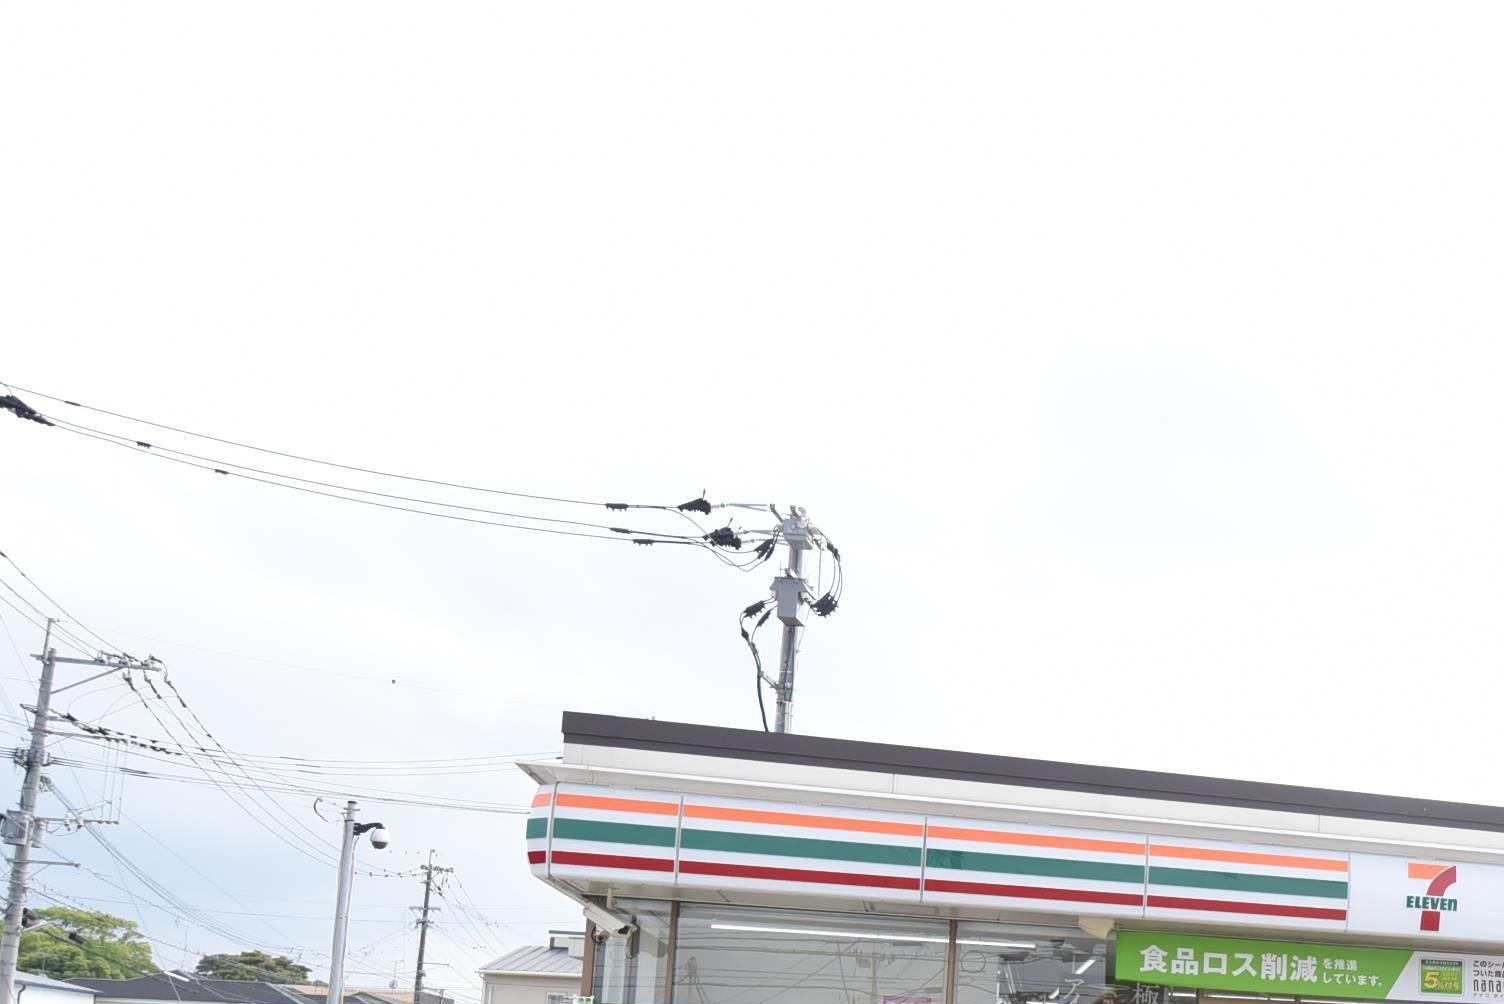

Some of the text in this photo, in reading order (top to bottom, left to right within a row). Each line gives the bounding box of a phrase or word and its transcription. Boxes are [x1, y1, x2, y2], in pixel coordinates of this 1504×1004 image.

[1139, 944, 1318, 983] 食品ロス削減
[1323, 958, 1358, 971] を推進
[1323, 972, 1383, 987] しています。
